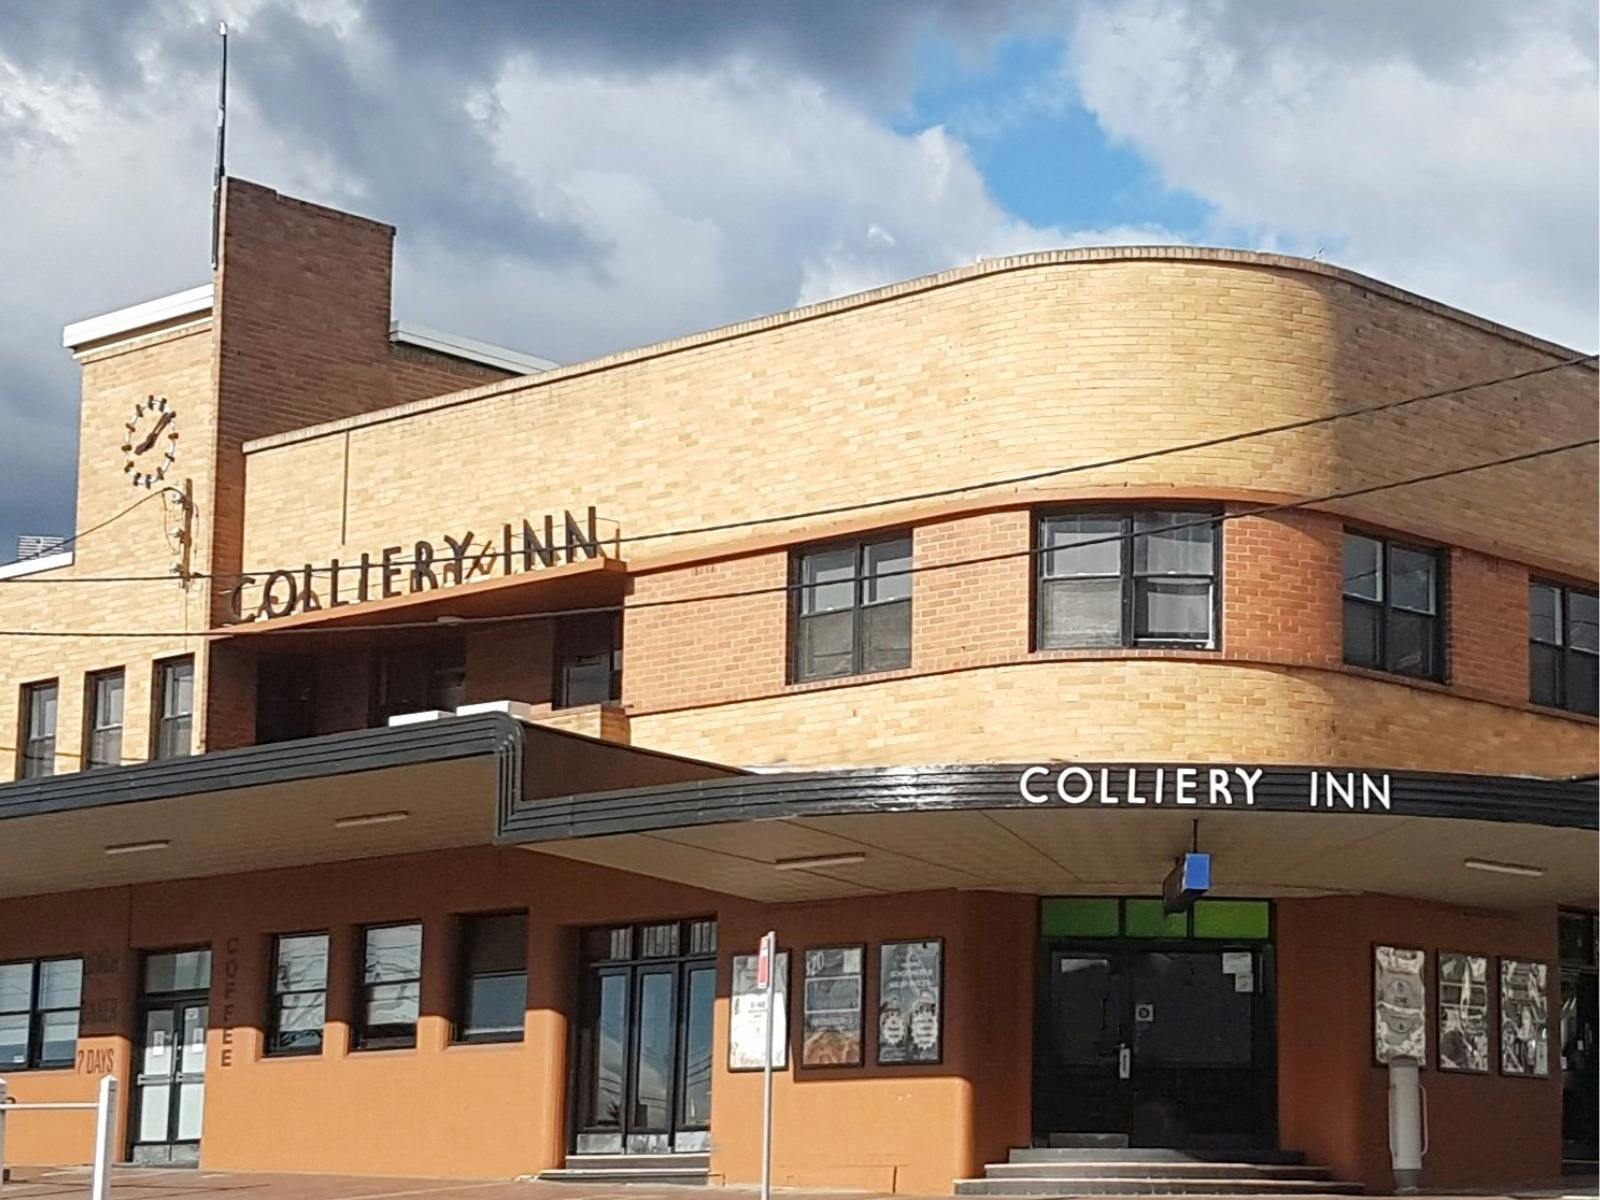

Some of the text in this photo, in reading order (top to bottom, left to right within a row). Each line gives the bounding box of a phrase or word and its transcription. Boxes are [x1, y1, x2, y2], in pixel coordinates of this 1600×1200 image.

[229, 505, 600, 625] COLLIERY INN
[1019, 766, 1391, 810] COLLIERY INN
[220, 936, 240, 1067] COFFEE
[86, 1047, 114, 1075] DAYS
